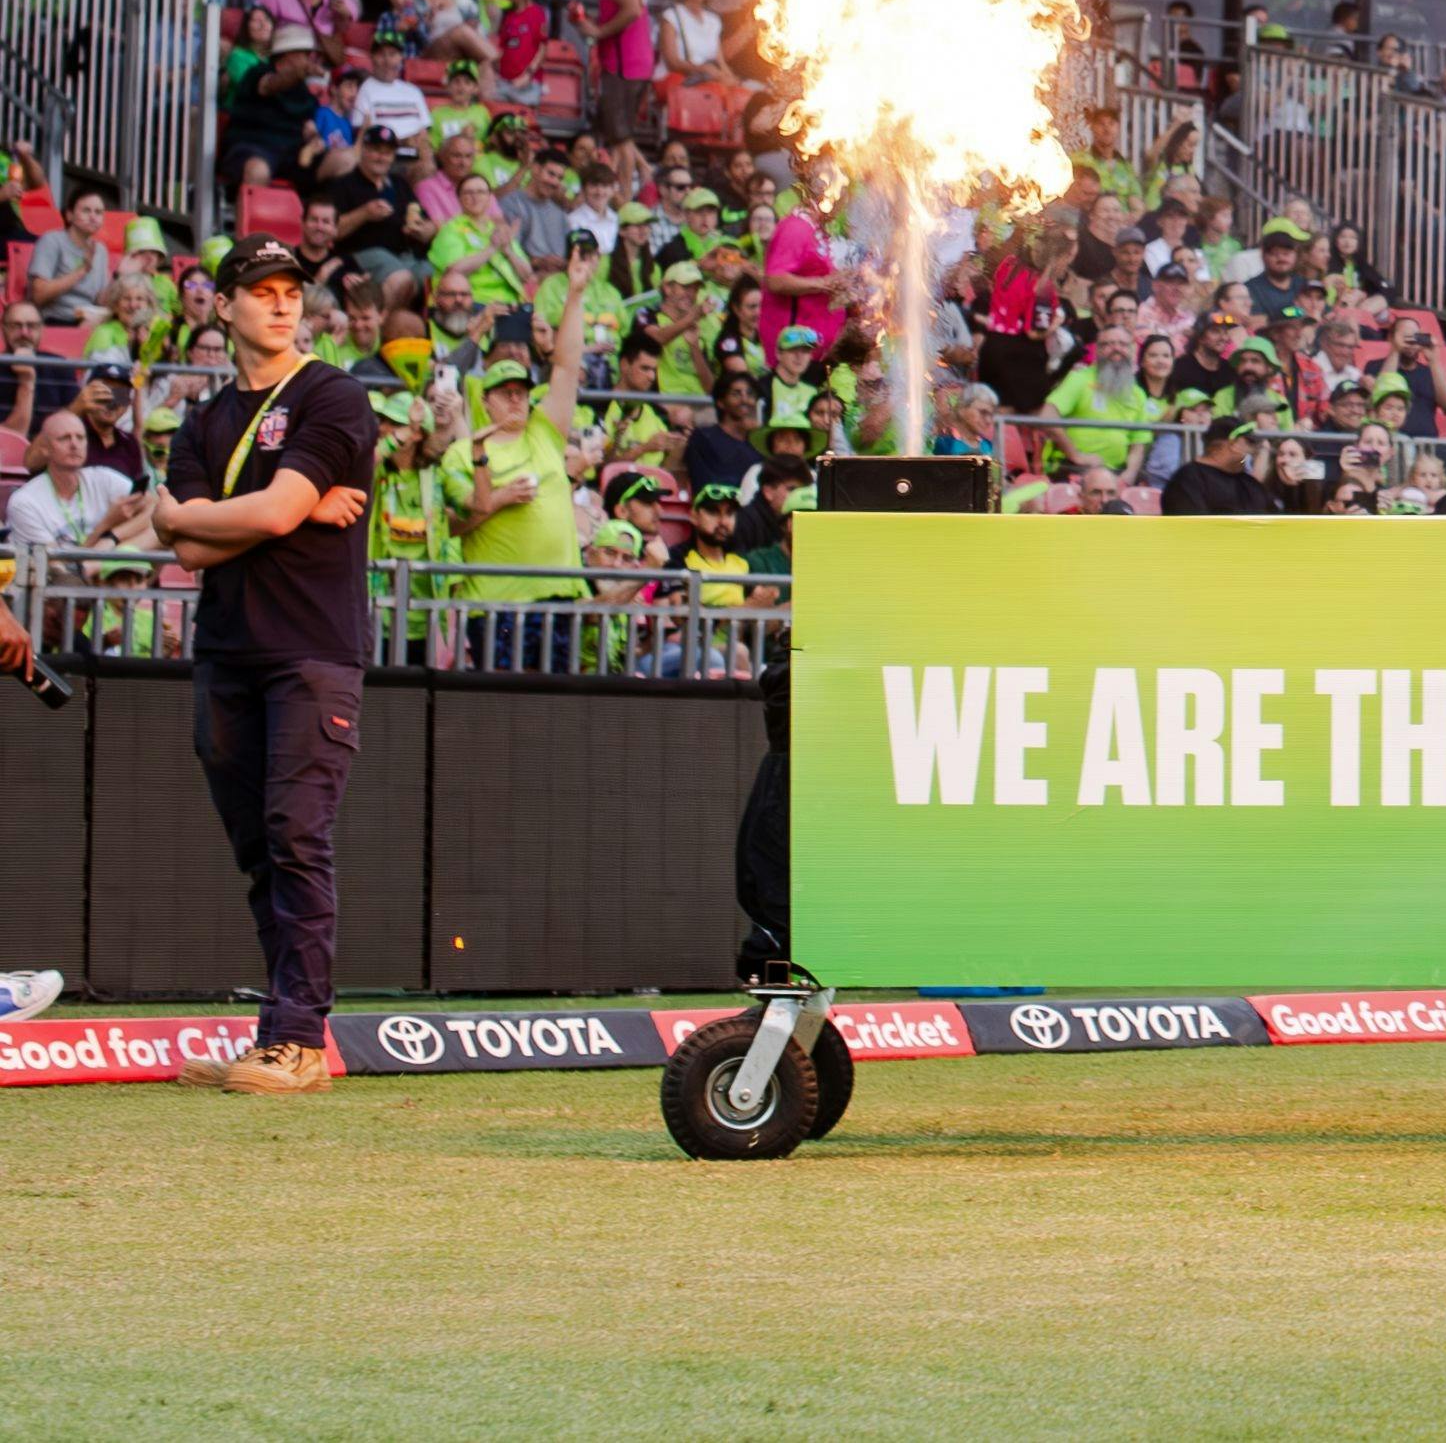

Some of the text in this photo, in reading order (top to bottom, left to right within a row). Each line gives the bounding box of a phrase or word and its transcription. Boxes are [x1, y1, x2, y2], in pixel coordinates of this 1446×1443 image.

[882, 665, 1048, 806] WE
[1077, 667, 1285, 806] ARE
[447, 1017, 624, 1059] TOYOTA
[834, 1007, 959, 1050] Cricket
[1071, 1004, 1231, 1042] TOYOTA
[1271, 1001, 1363, 1036] Good
[1359, 1000, 1409, 1034] for
[0, 1024, 258, 1070] Good for Cric
